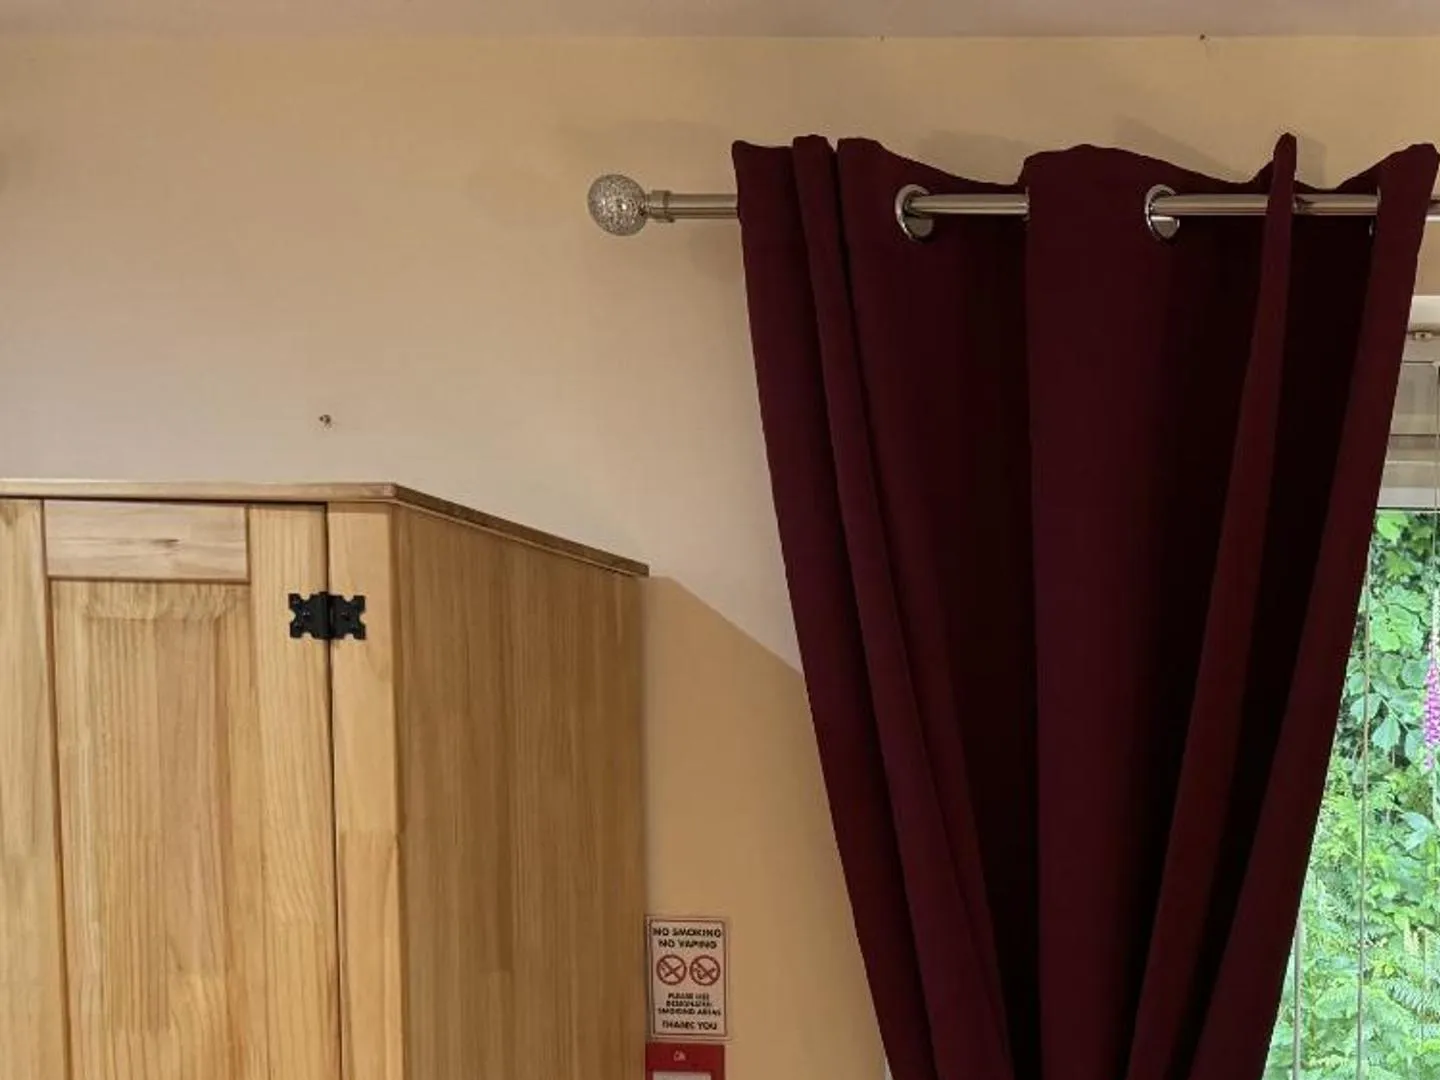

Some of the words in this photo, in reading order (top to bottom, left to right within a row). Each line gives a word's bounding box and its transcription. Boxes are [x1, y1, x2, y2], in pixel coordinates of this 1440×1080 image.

[653, 928, 669, 936] NO
[673, 928, 721, 938] SMOKING
[659, 940, 675, 948] NO
[678, 940, 717, 949] VAPING
[662, 1020, 695, 1029] THANK
[697, 1021, 717, 1030] YOU
